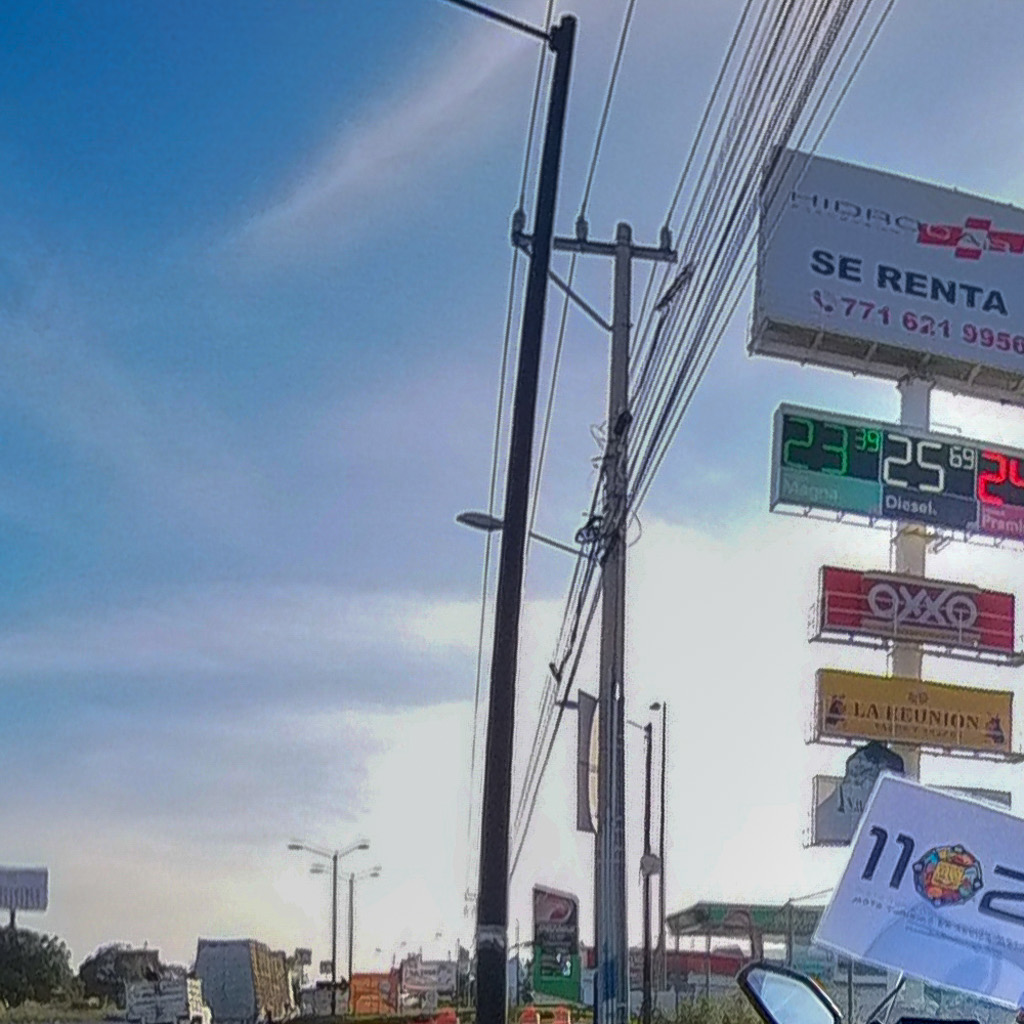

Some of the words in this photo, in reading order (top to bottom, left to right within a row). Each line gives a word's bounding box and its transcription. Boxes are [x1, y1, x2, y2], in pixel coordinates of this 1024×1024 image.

[810, 250, 862, 284] SE
[877, 263, 1008, 316] RENTA
[840, 297, 891, 326] 771
[902, 311, 951, 338] 621
[867, 583, 978, 629] OXXO
[853, 702, 879, 720] LA
[860, 825, 915, 890] 11
